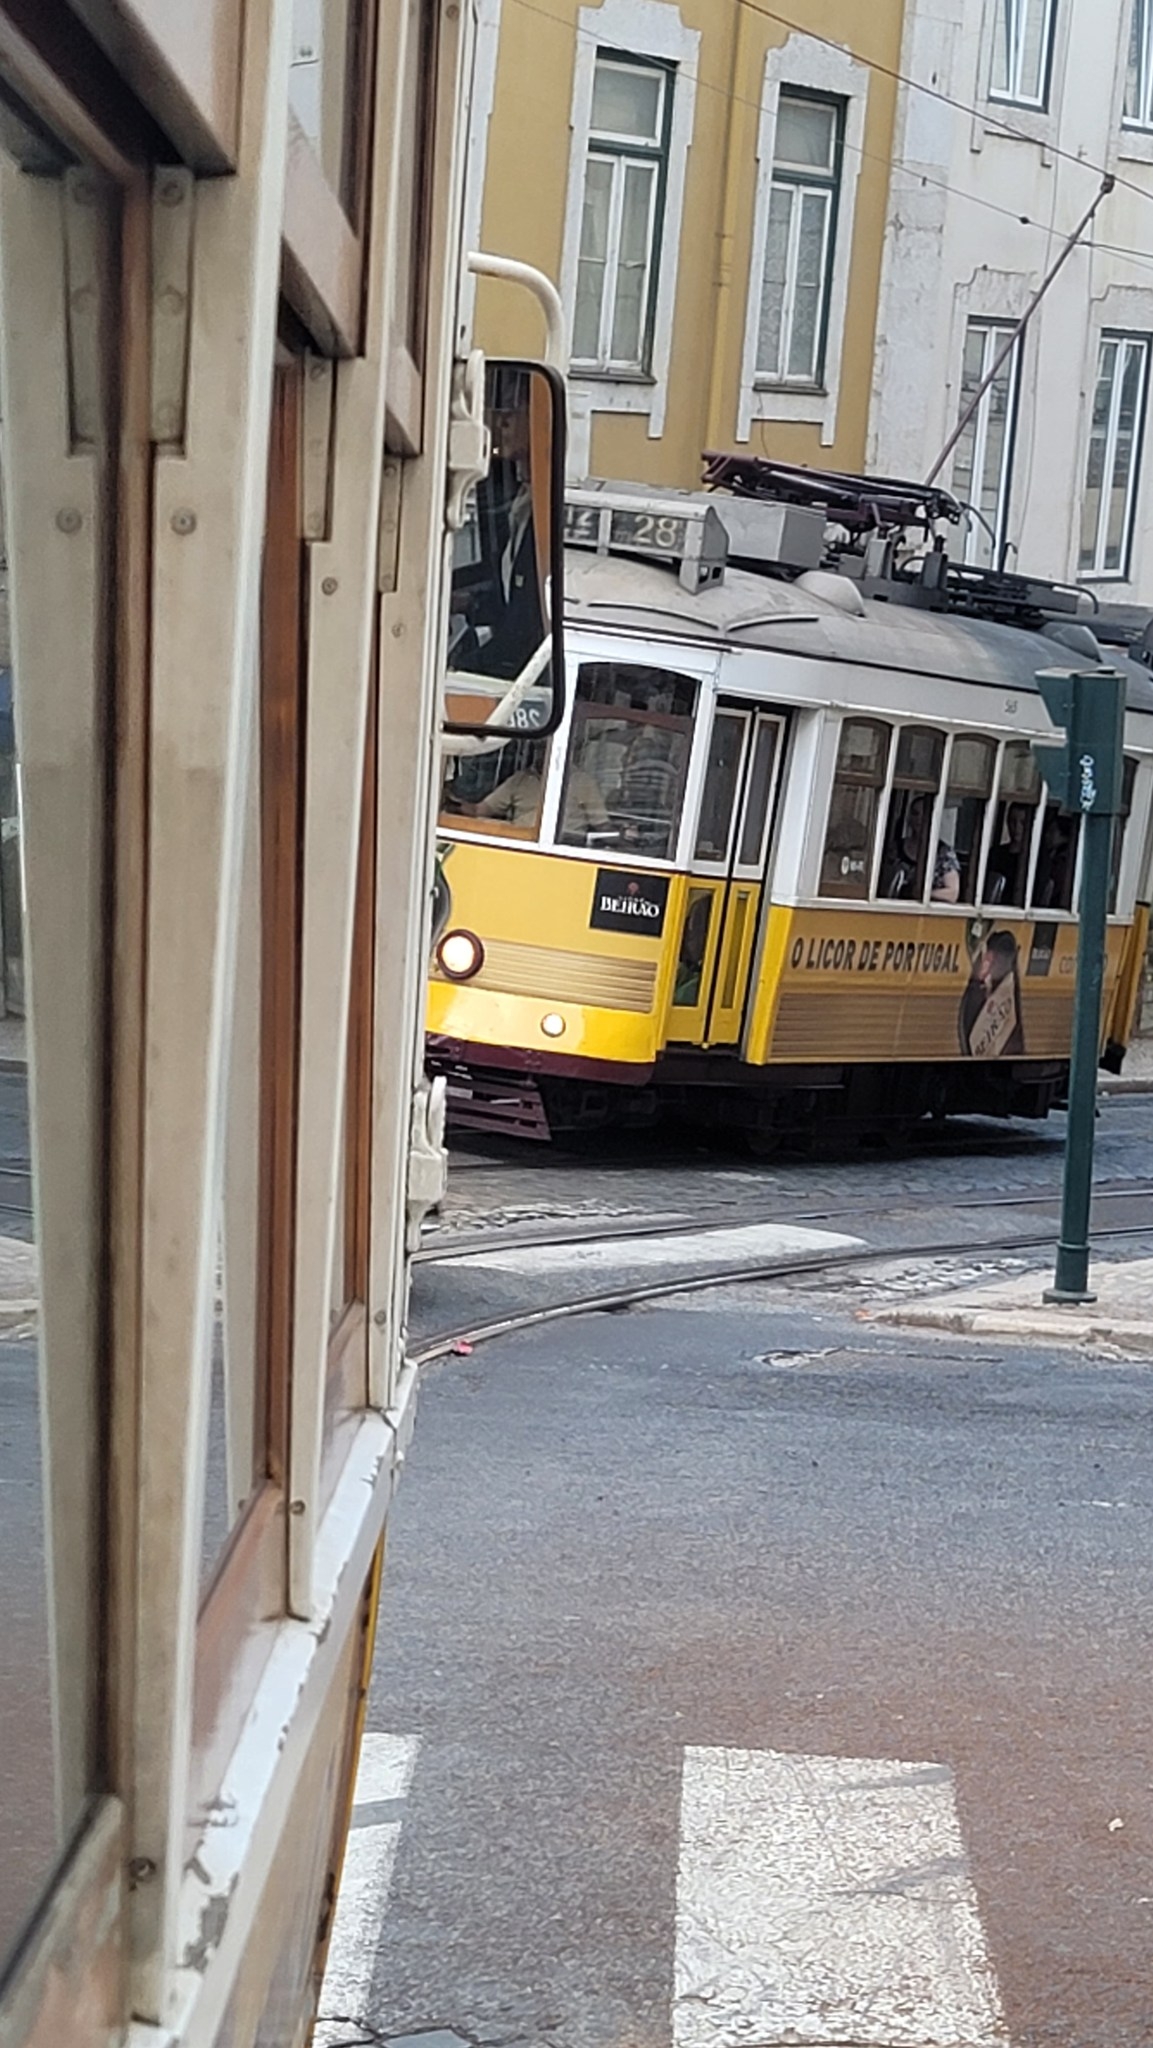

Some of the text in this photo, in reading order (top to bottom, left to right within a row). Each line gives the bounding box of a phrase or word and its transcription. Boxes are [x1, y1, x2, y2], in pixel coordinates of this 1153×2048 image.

[633, 514, 678, 547] 28
[791, 937, 960, 973] O LICOR DE PORTUGAL
